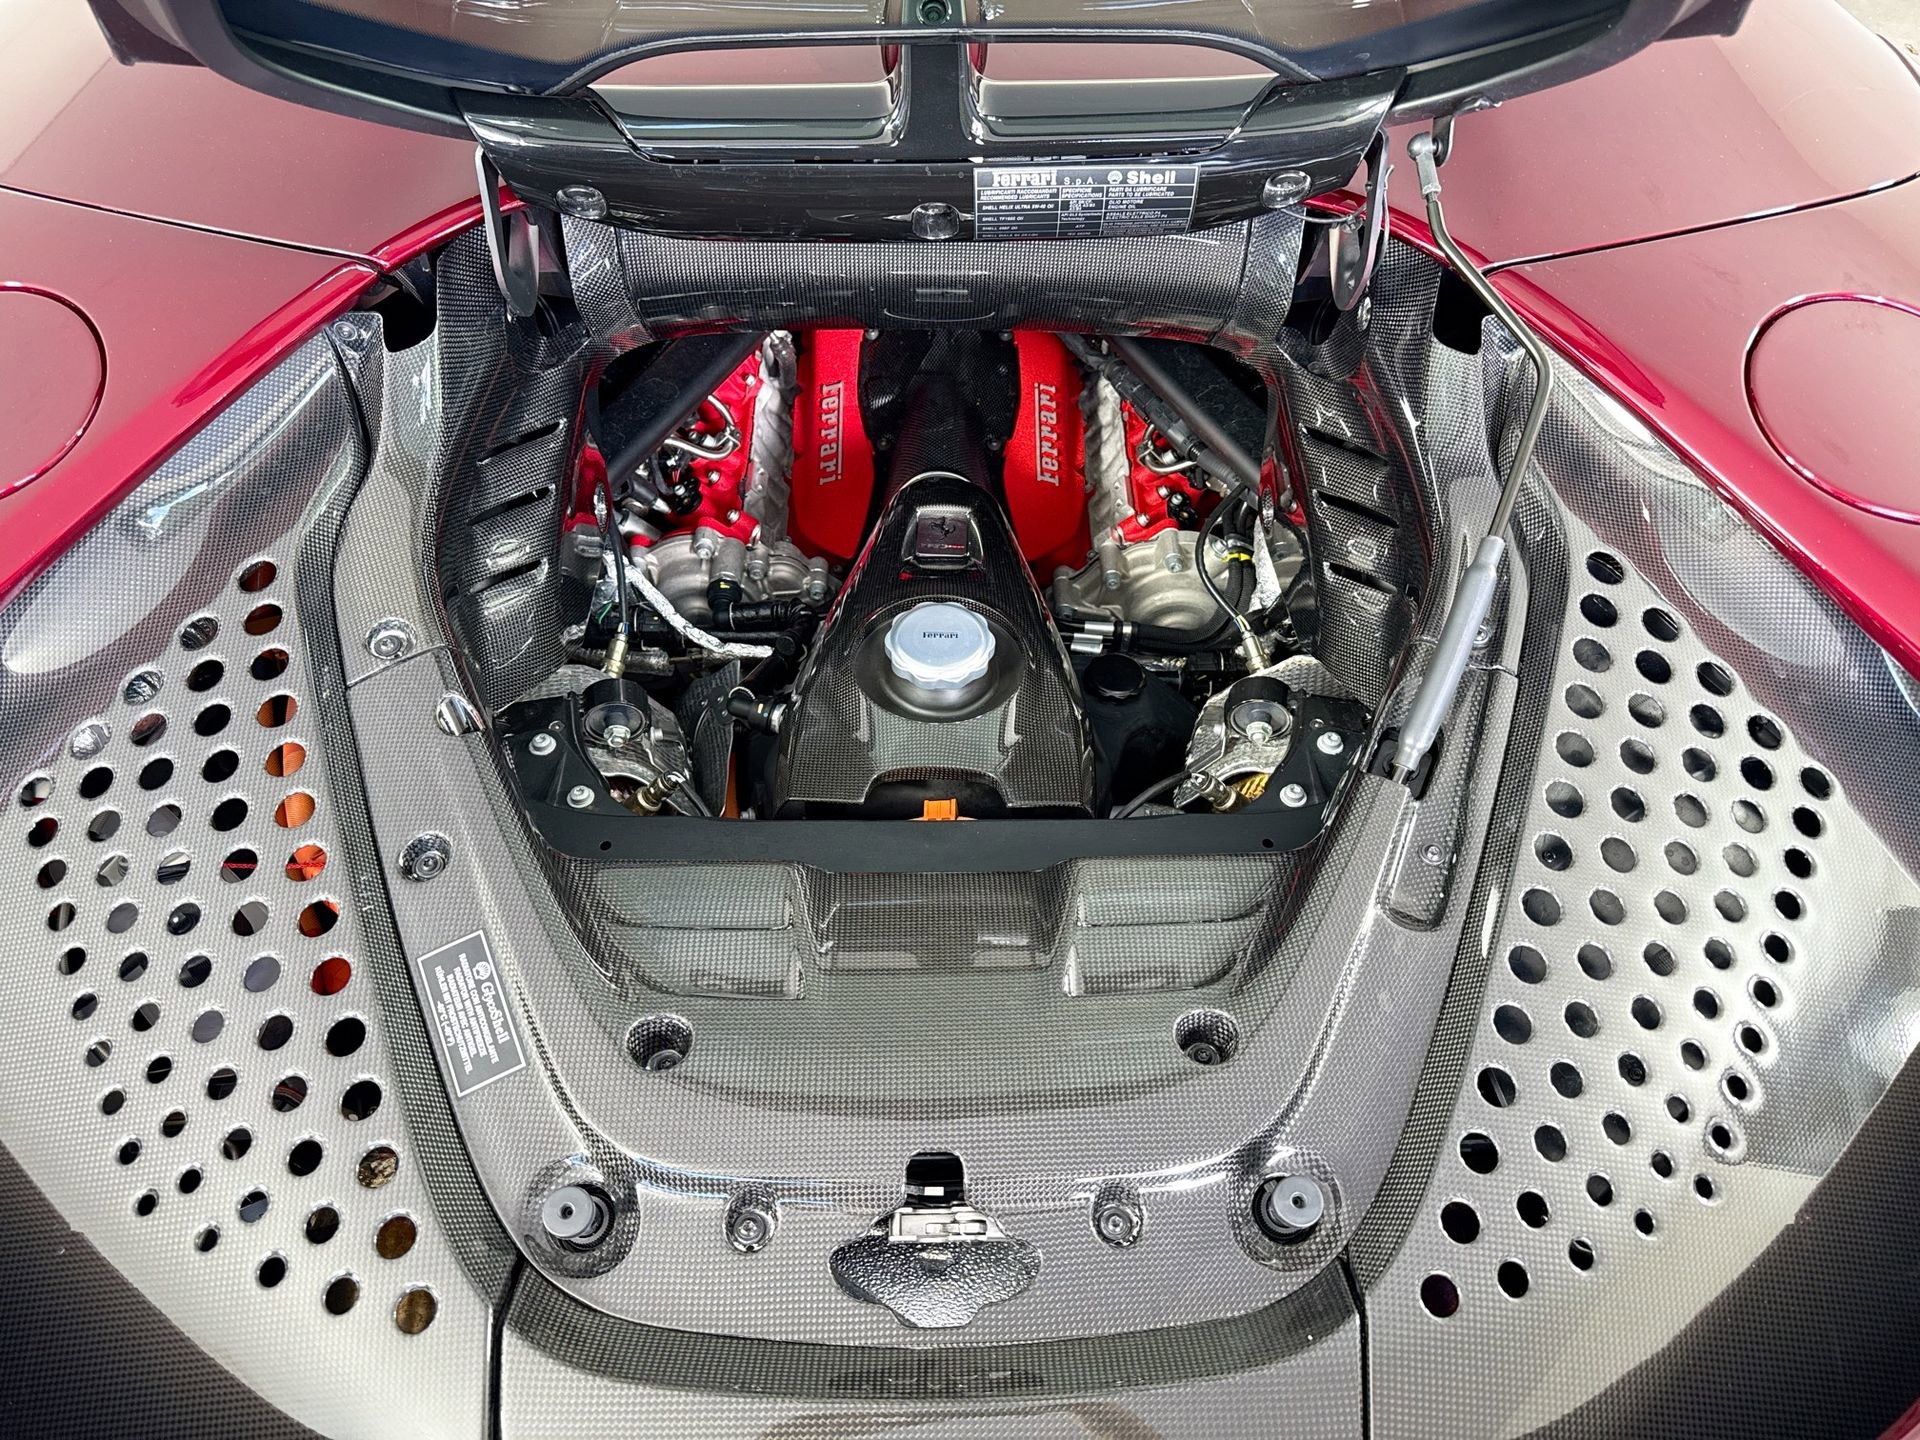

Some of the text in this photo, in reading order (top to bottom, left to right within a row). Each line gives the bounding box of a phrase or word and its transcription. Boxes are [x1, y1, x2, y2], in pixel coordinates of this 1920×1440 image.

[992, 171, 1098, 187] Ferrari S.p.A.
[1126, 170, 1176, 184] Shell
[818, 380, 844, 485] Ferrari
[1034, 382, 1060, 487] Ferrari
[922, 631, 959, 639] Ferrari
[458, 953, 476, 990] RADIATORE
[446, 974, 463, 1011] RADIATEUR
[453, 966, 469, 1000] RADIATOR
[464, 999, 475, 1018] WITH
[481, 982, 510, 1044] GlycoShell
